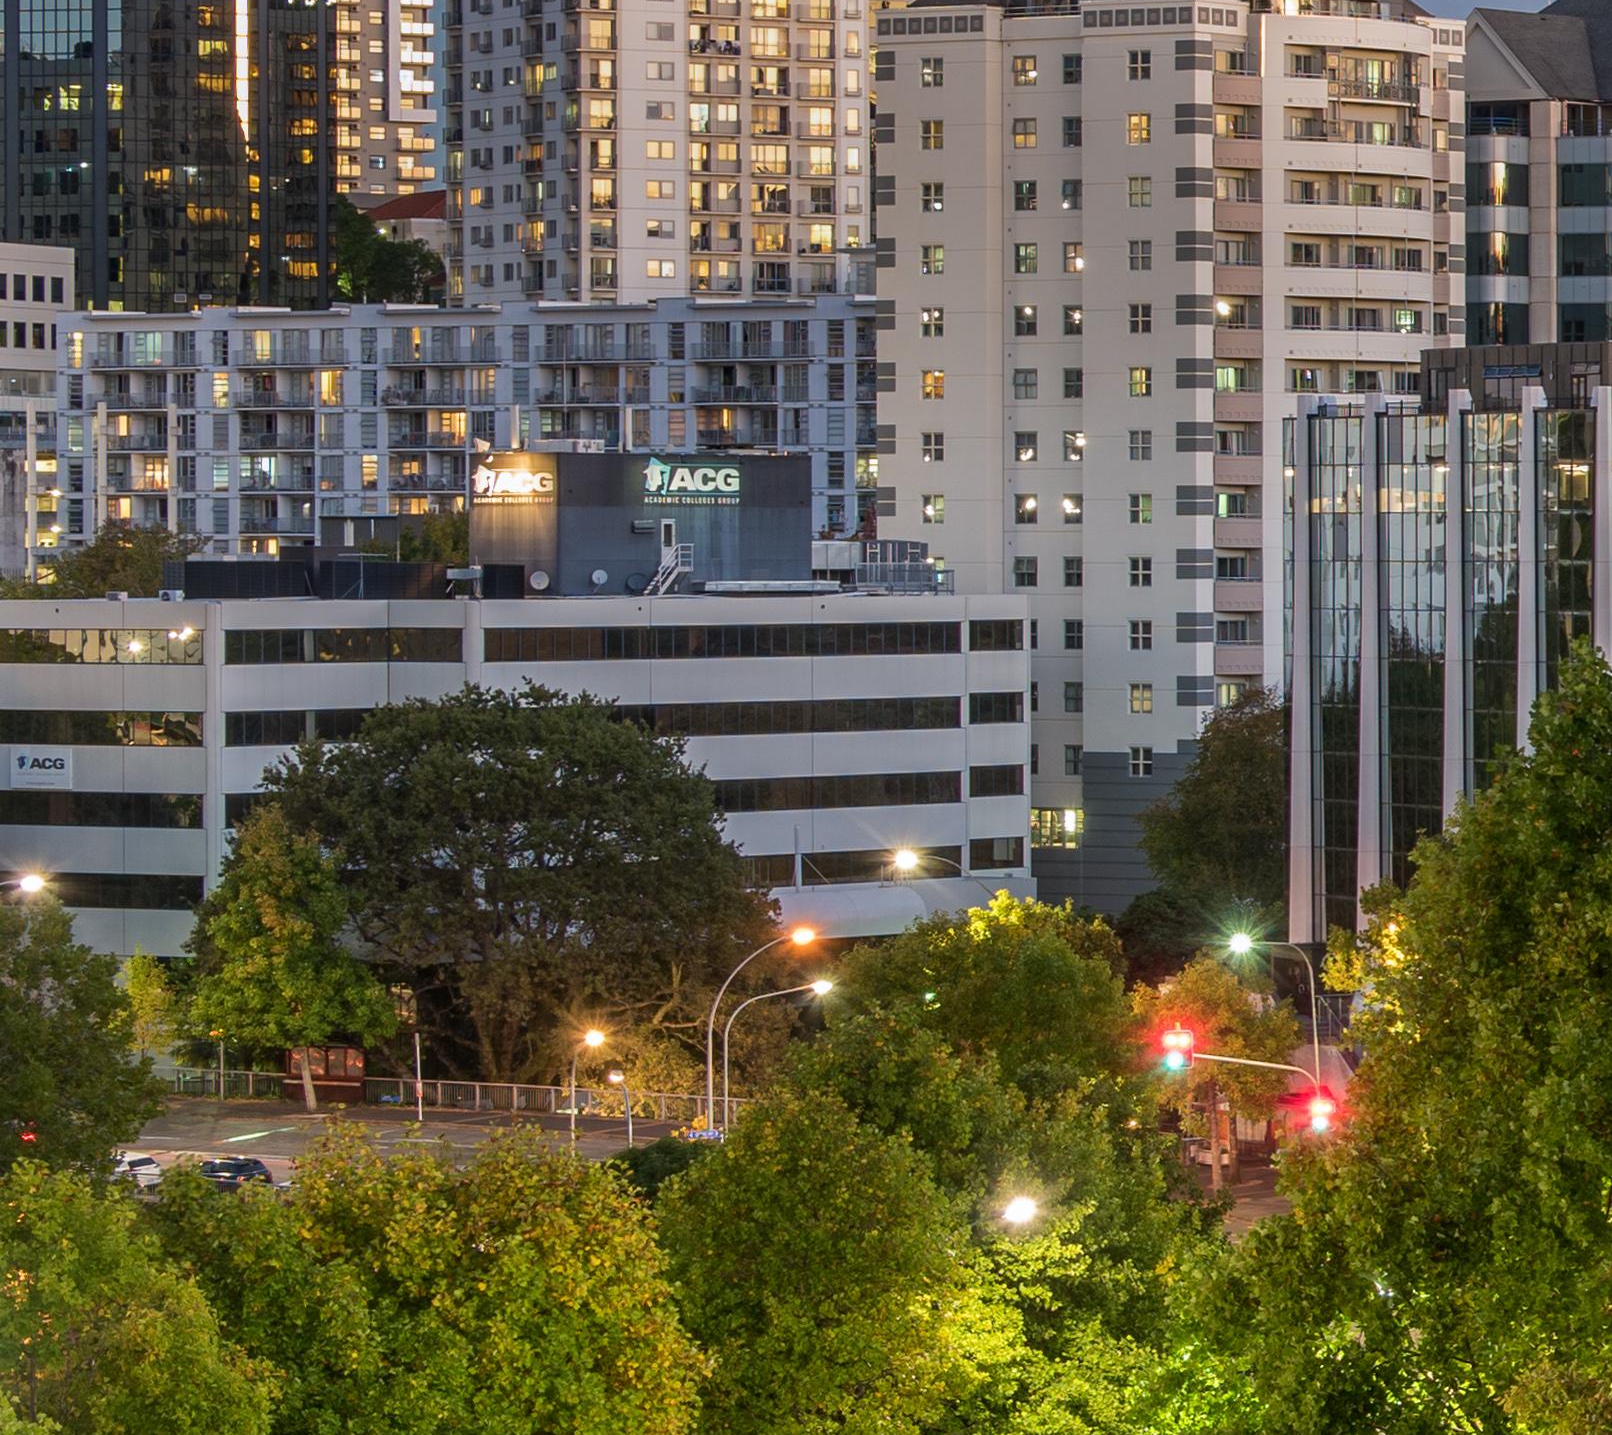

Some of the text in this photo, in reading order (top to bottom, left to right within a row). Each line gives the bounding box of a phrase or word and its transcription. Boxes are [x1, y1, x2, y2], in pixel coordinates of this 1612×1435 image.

[671, 467, 740, 492] ACG
[644, 496, 740, 504] ACADEMIC COLLEGES GROUP
[30, 757, 65, 770] ACG
